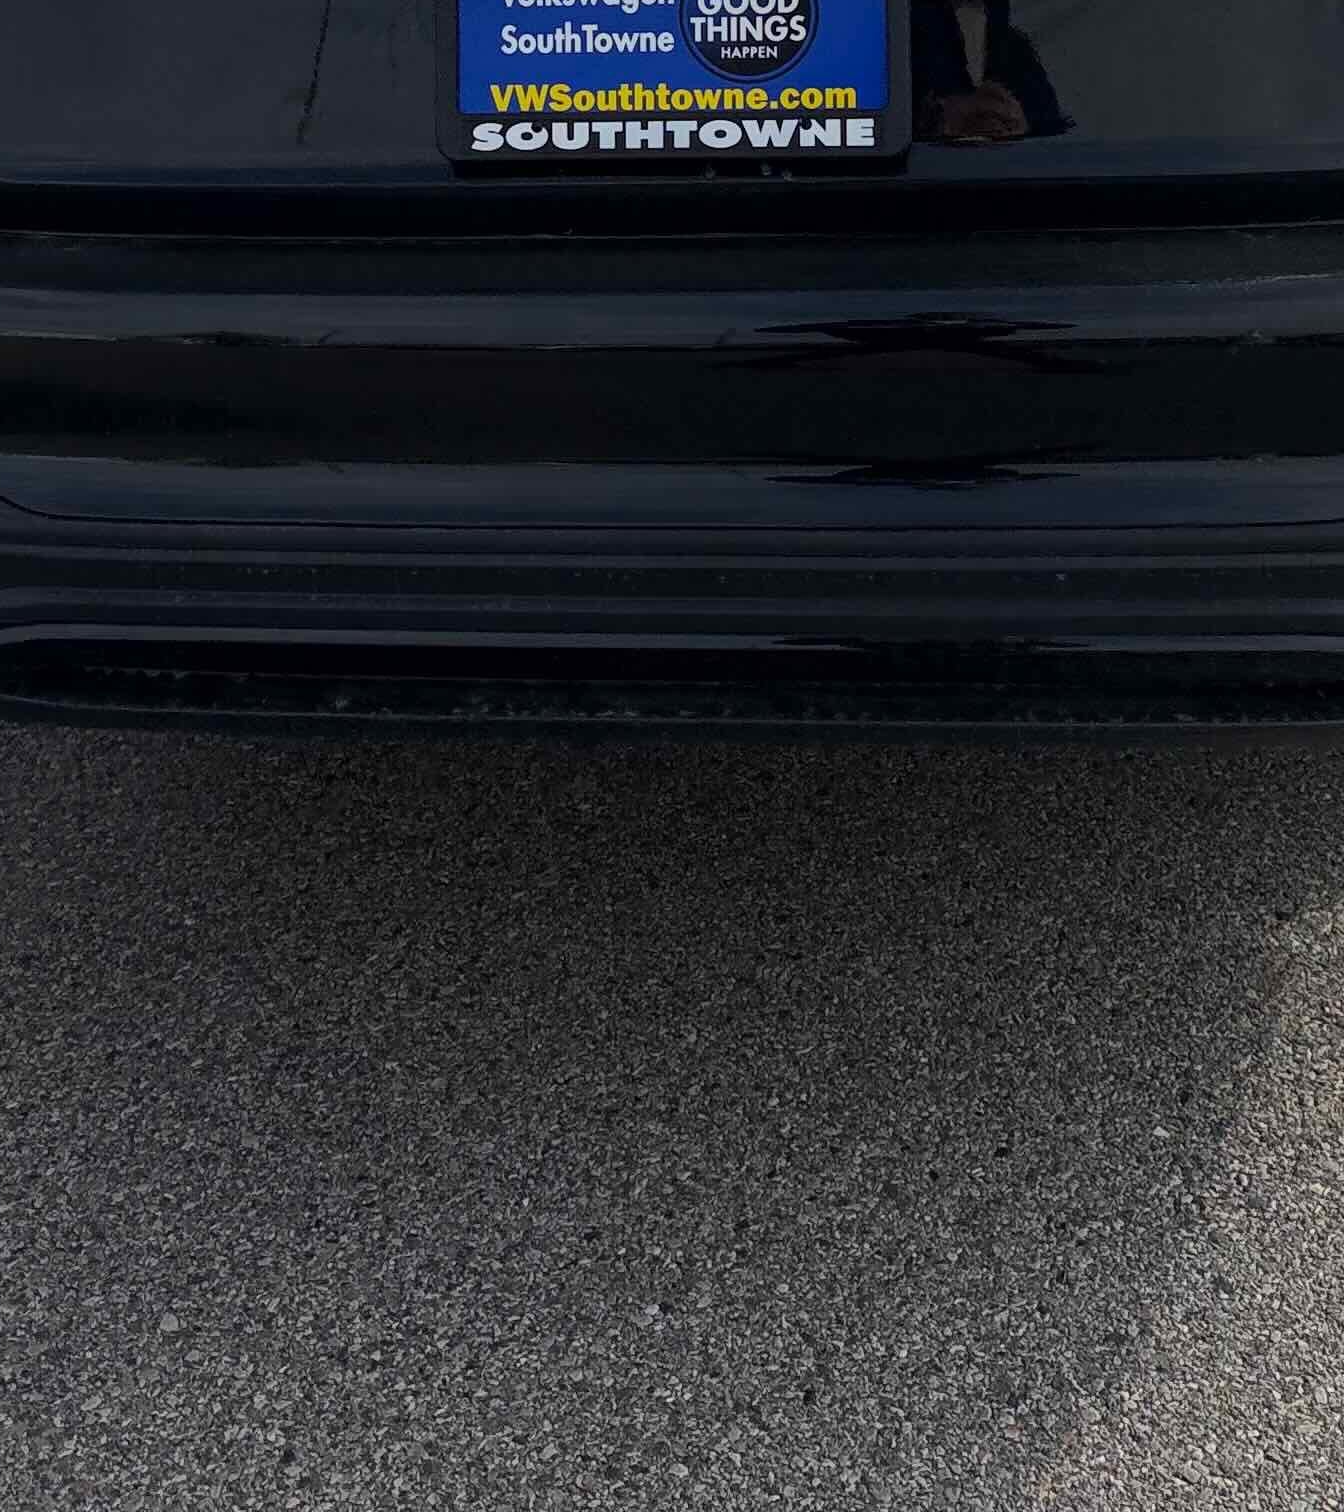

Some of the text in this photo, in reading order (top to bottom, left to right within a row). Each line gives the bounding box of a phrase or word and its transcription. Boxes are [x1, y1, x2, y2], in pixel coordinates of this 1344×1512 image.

[500, 21, 675, 55] SouthTowne
[690, 15, 807, 43] THINGS
[720, 46, 778, 60] HAPPEN
[490, 82, 857, 113] VWSouthtowne.com
[471, 118, 875, 152] SOUTHTOWNE
